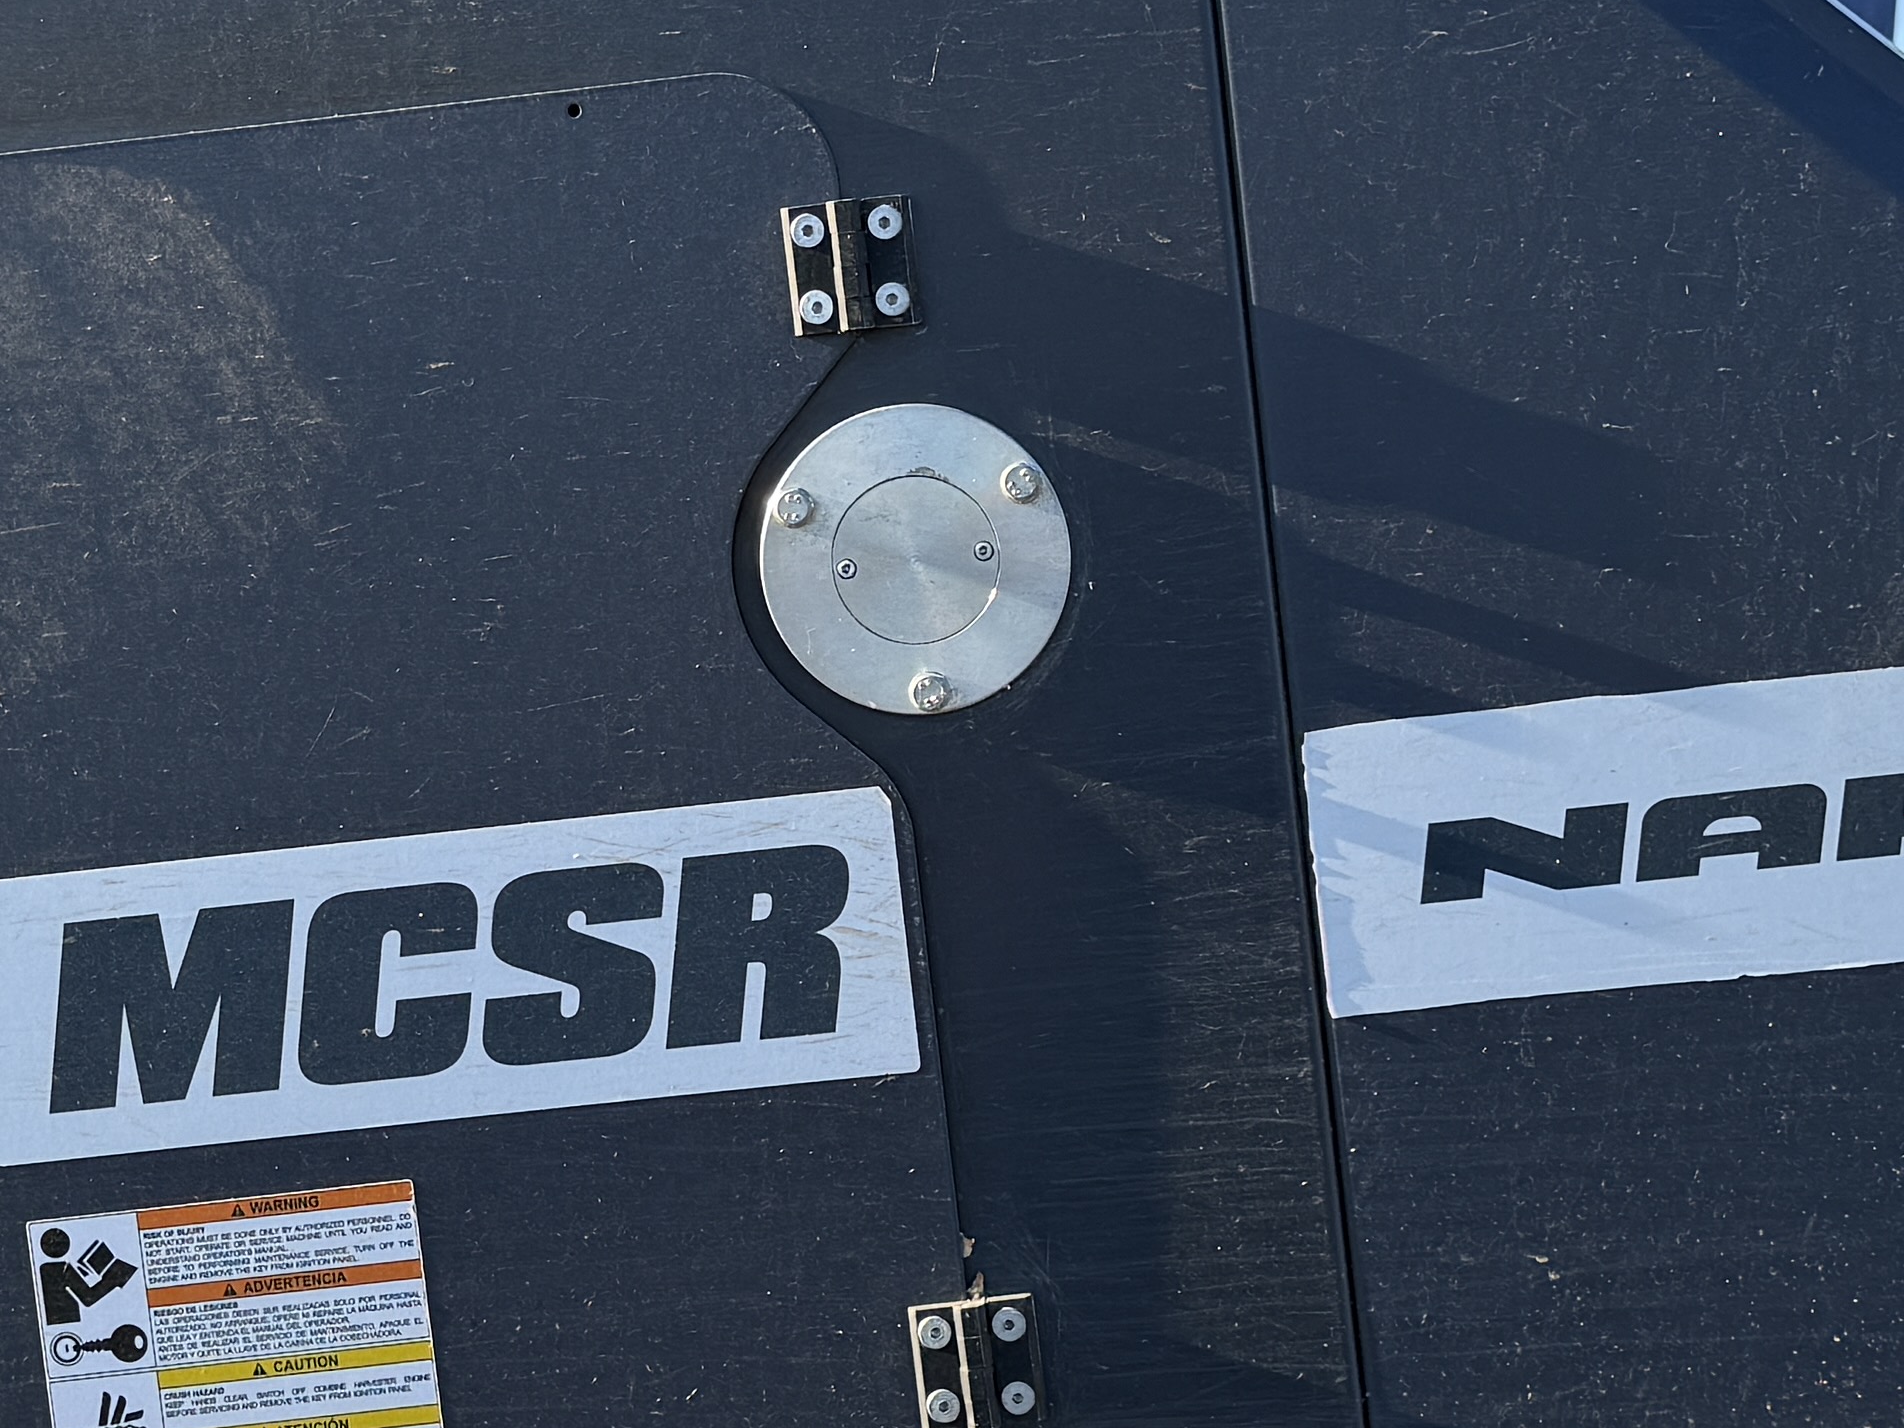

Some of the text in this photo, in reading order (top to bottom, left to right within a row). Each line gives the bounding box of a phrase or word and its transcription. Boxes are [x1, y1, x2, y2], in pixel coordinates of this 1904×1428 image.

[49, 844, 850, 1115] MCSR
[249, 1195, 319, 1214] WARNING
[243, 1271, 347, 1293] ADVERTENCIA
[273, 1355, 339, 1373] CAUTION
